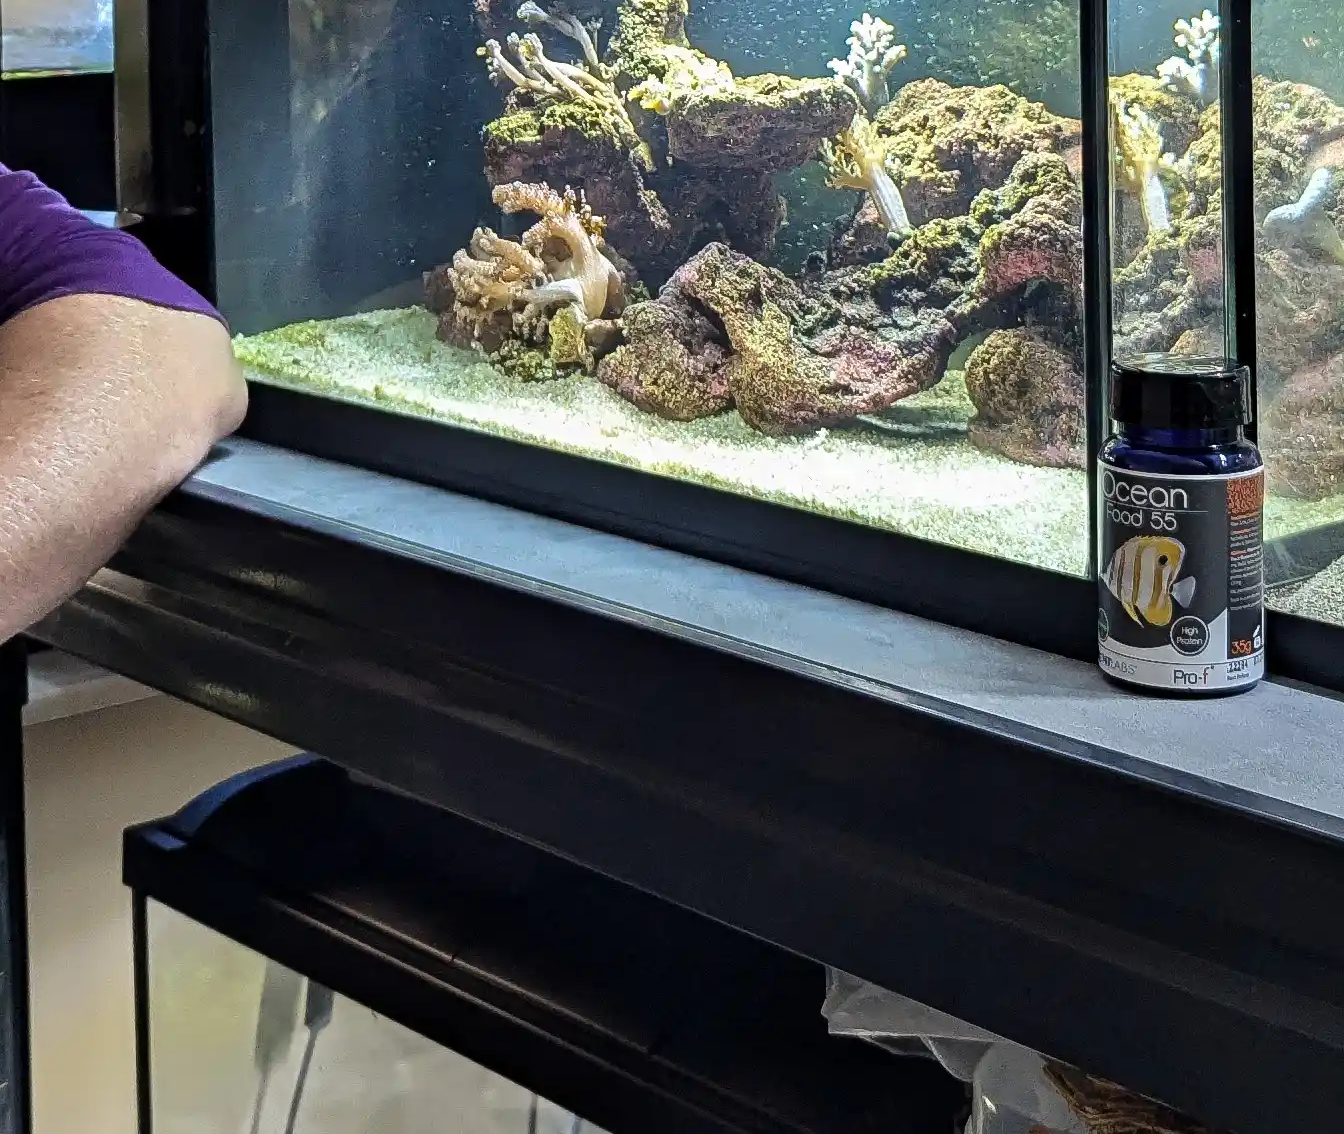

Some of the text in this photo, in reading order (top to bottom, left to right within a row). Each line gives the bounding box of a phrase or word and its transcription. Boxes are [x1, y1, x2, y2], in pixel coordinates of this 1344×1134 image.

[1102, 471, 1188, 508] Ocean
[1107, 503, 1177, 531] Food 55
[1181, 626, 1199, 636] High
[1176, 636, 1203, 646] Protein
[1231, 639, 1252, 654] 35g
